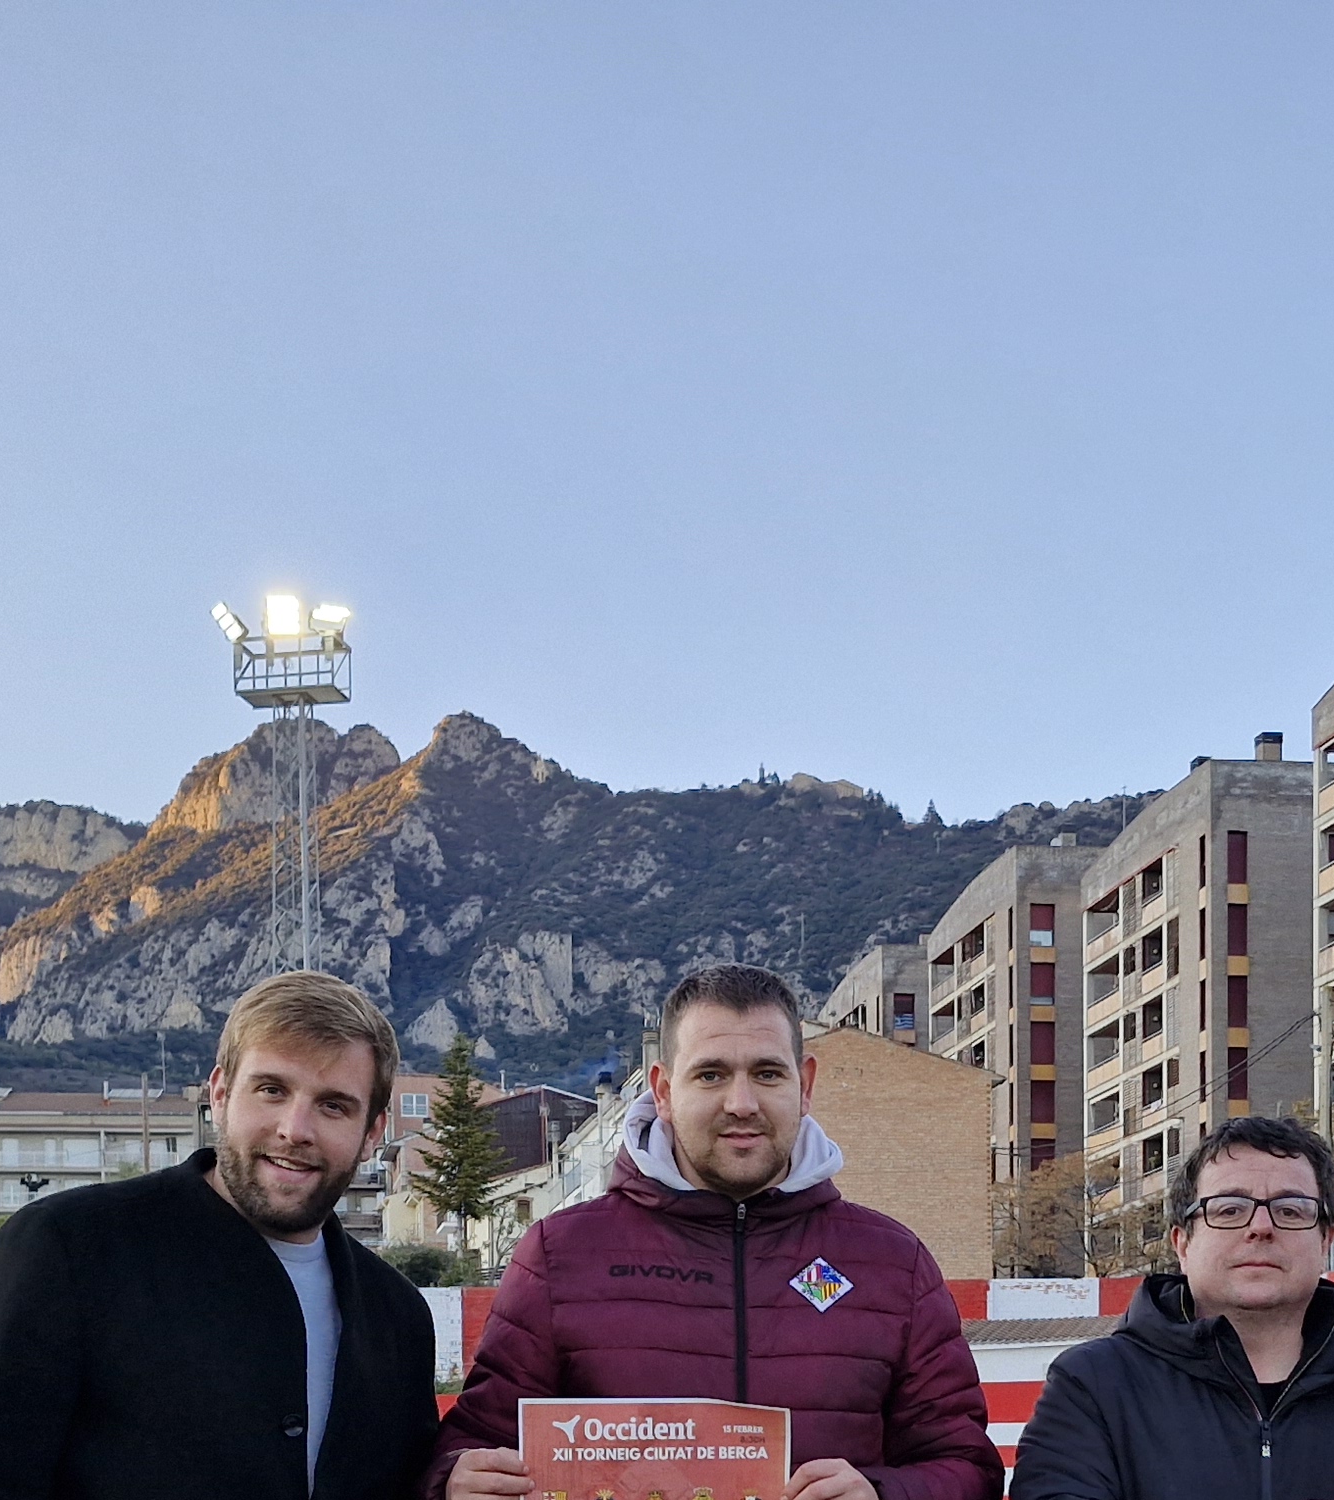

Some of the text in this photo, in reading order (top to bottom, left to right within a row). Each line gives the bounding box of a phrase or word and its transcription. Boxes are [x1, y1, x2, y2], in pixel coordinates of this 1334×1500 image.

[584, 1417, 696, 1441] Occident
[722, 1425, 764, 1434] 15 FEBRER
[552, 1446, 768, 1462] XII TORNEIG CIUTAT DE BERGA
